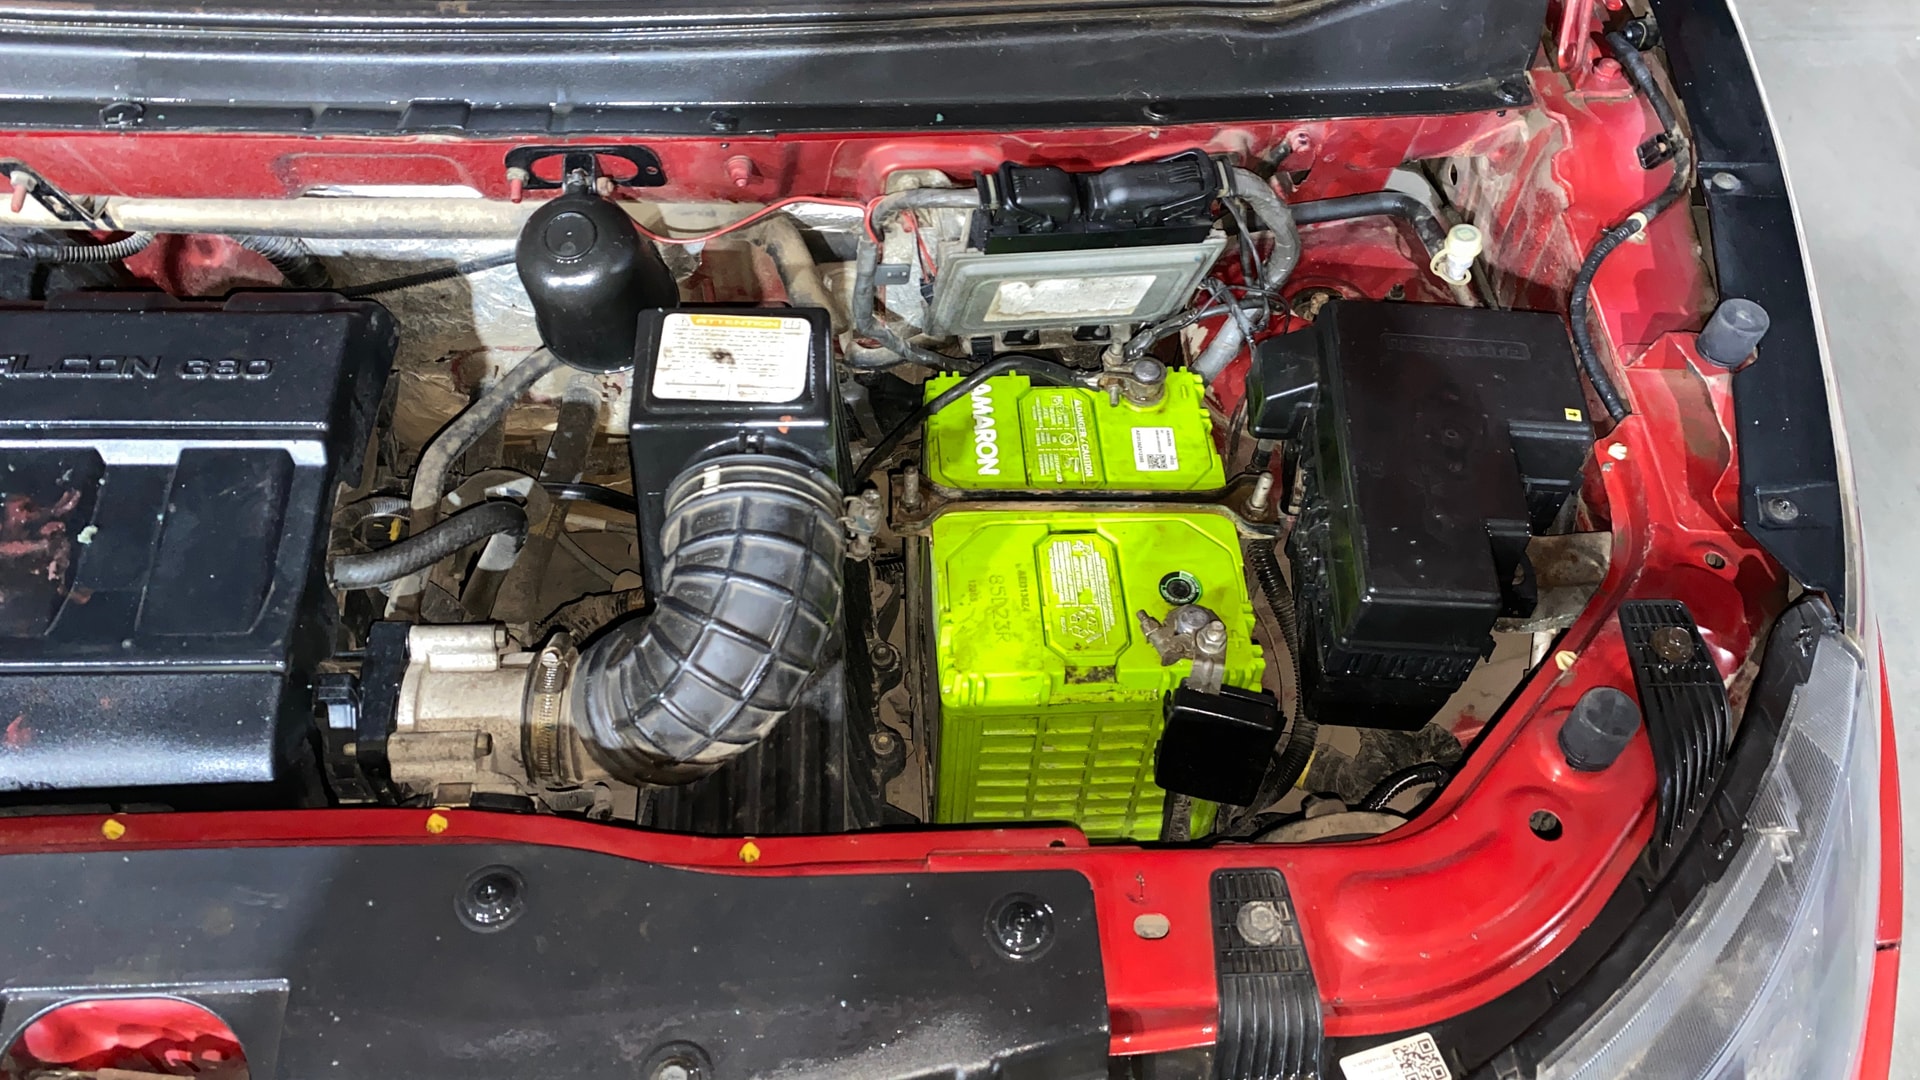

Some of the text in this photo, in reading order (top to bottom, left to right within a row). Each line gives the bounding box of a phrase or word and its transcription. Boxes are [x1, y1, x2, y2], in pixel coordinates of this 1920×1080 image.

[696, 317, 778, 328] ATTENTION
[971, 383, 1001, 476] AMARON
[1076, 407, 1088, 437] DANGER
[1081, 444, 1094, 477] CAUTION
